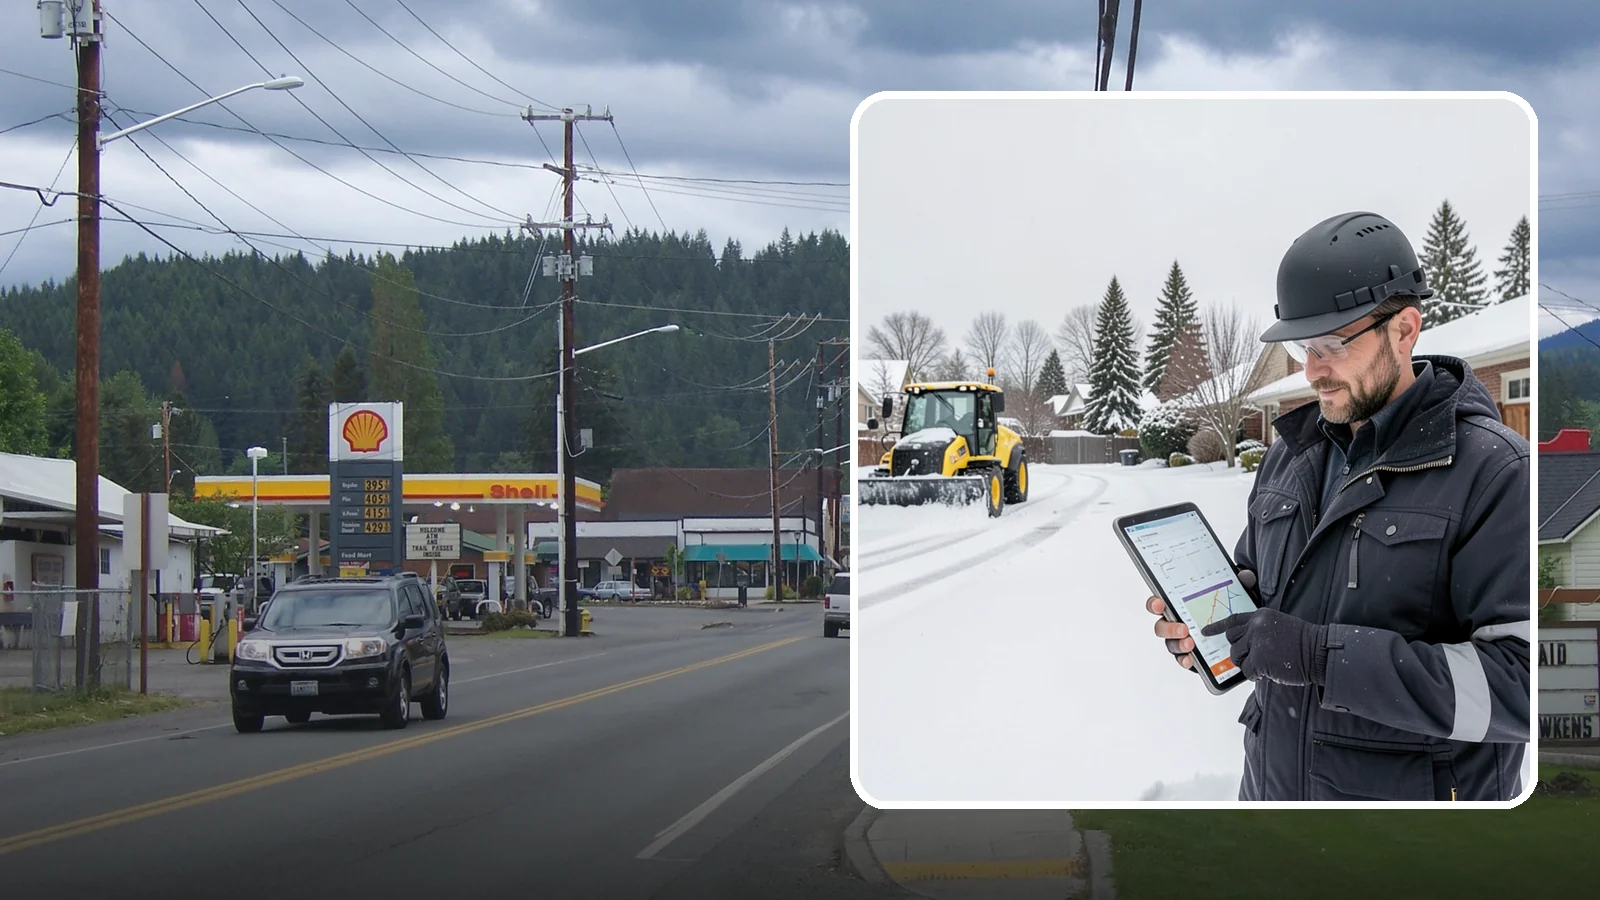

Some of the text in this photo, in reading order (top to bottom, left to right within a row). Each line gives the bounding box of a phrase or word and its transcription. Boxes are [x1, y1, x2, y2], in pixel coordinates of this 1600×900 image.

[366, 480, 383, 490] 395
[490, 484, 548, 499] Shell
[366, 494, 383, 504] 405
[366, 508, 383, 518] 415
[366, 522, 383, 532] 429
[1538, 642, 1566, 665] AID
[1538, 716, 1592, 739] WKENS
